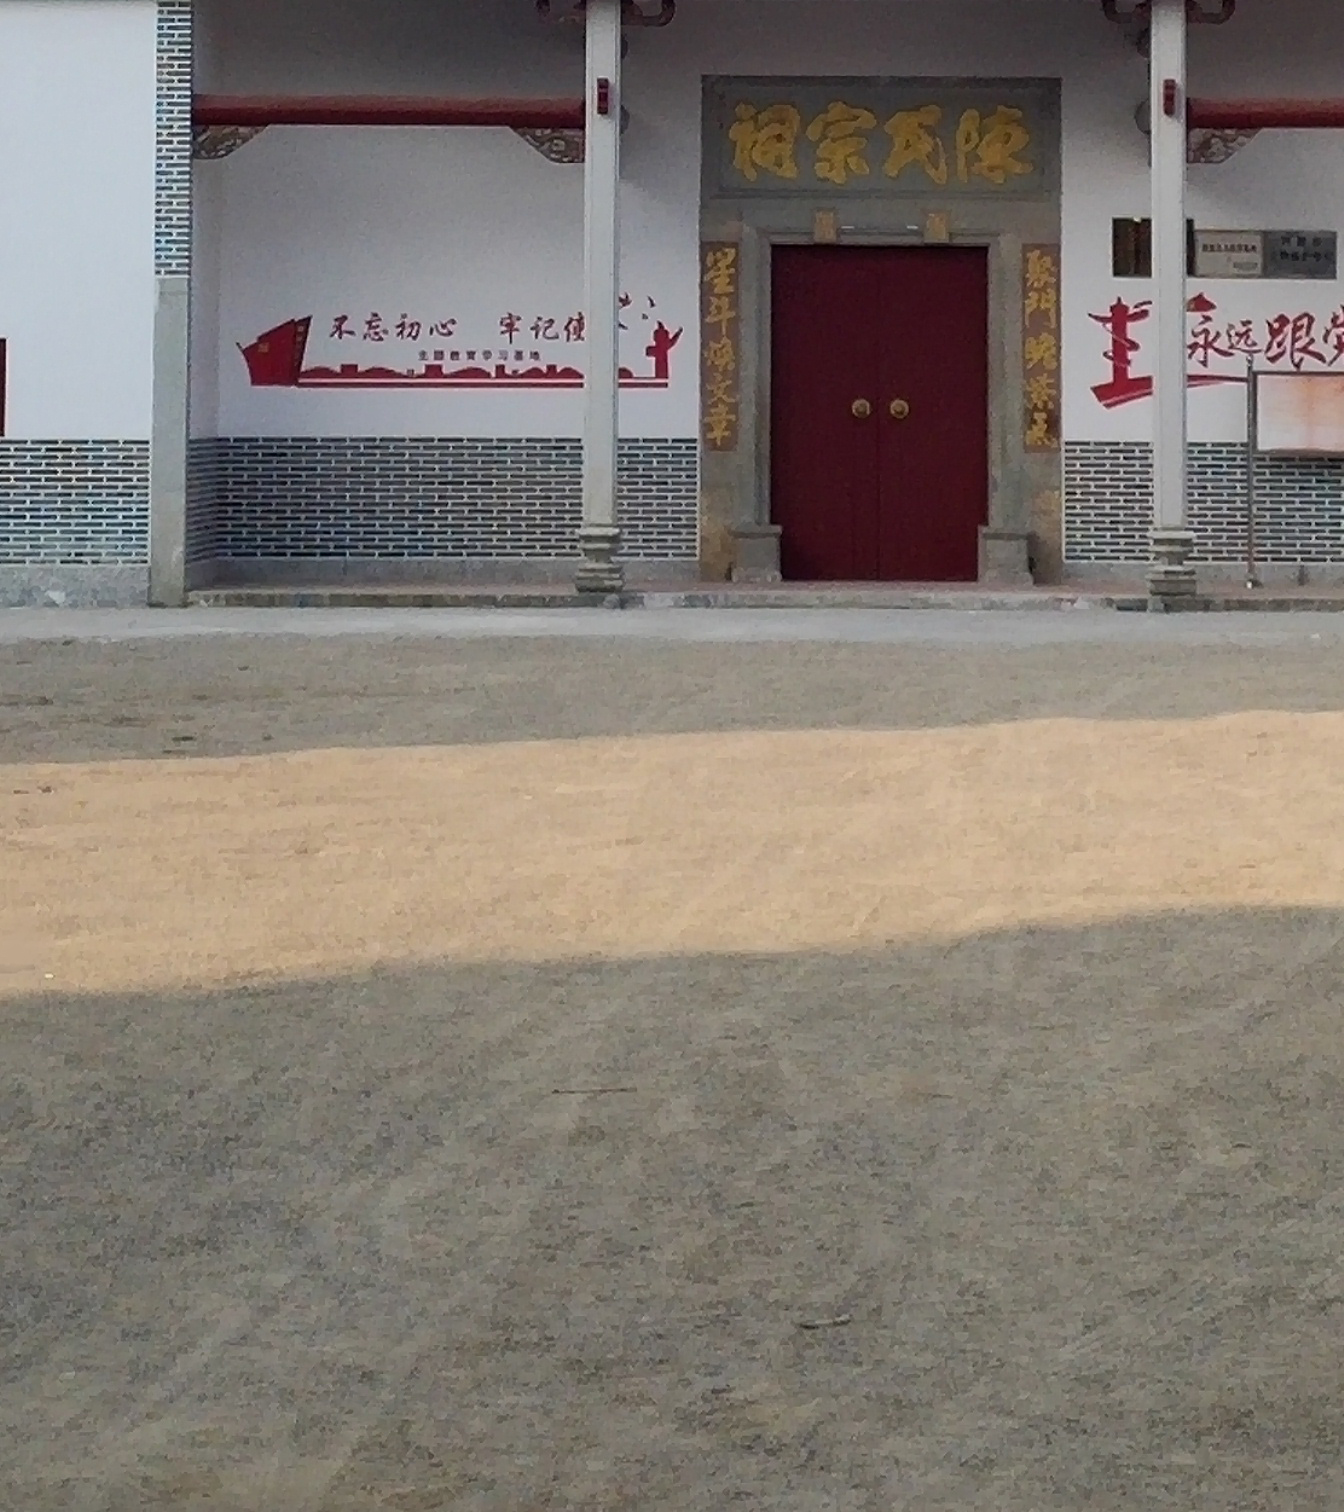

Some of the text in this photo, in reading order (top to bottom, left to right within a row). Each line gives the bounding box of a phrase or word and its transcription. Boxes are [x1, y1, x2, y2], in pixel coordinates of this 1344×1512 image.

[330, 311, 628, 344] 不忘初心 牢记使
